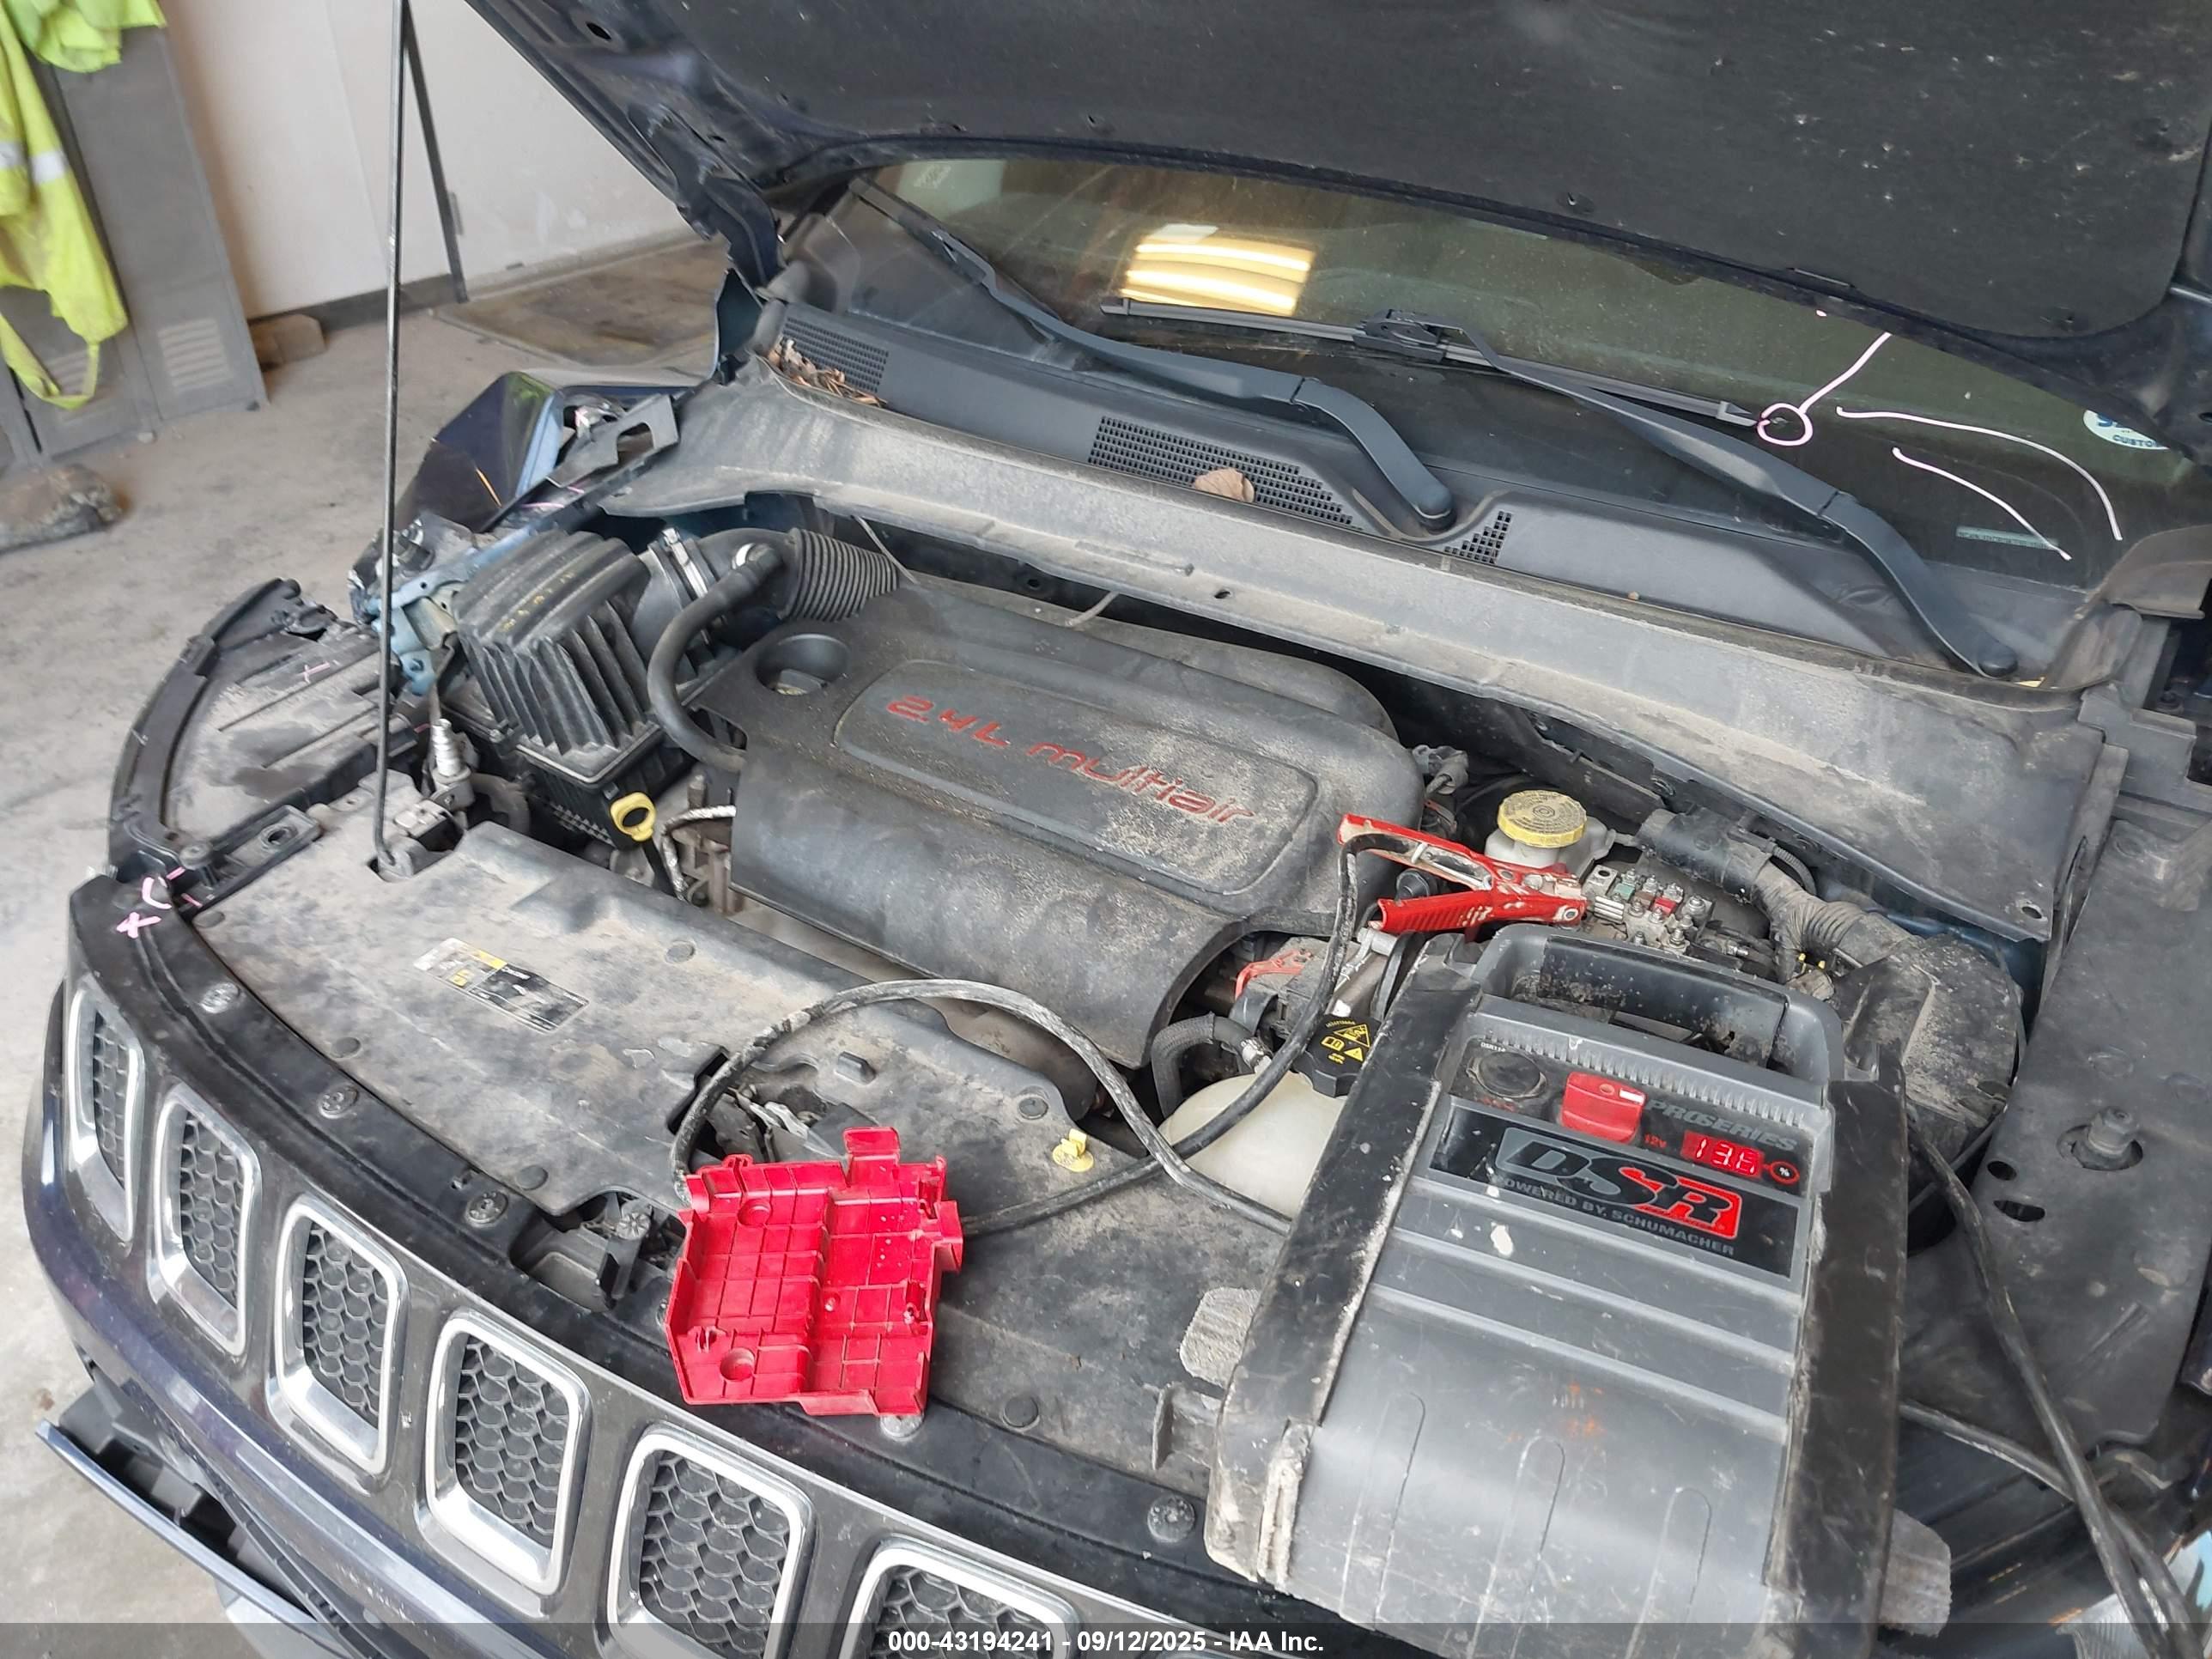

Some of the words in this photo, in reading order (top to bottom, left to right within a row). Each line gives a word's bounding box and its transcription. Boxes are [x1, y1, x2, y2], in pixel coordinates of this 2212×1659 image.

[1026, 742, 1256, 823] multiair
[1644, 1098, 1798, 1152] PROSERIES
[1503, 1135, 1736, 1229] DSR
[1611, 1200, 1735, 1256] SCHUMACHER
